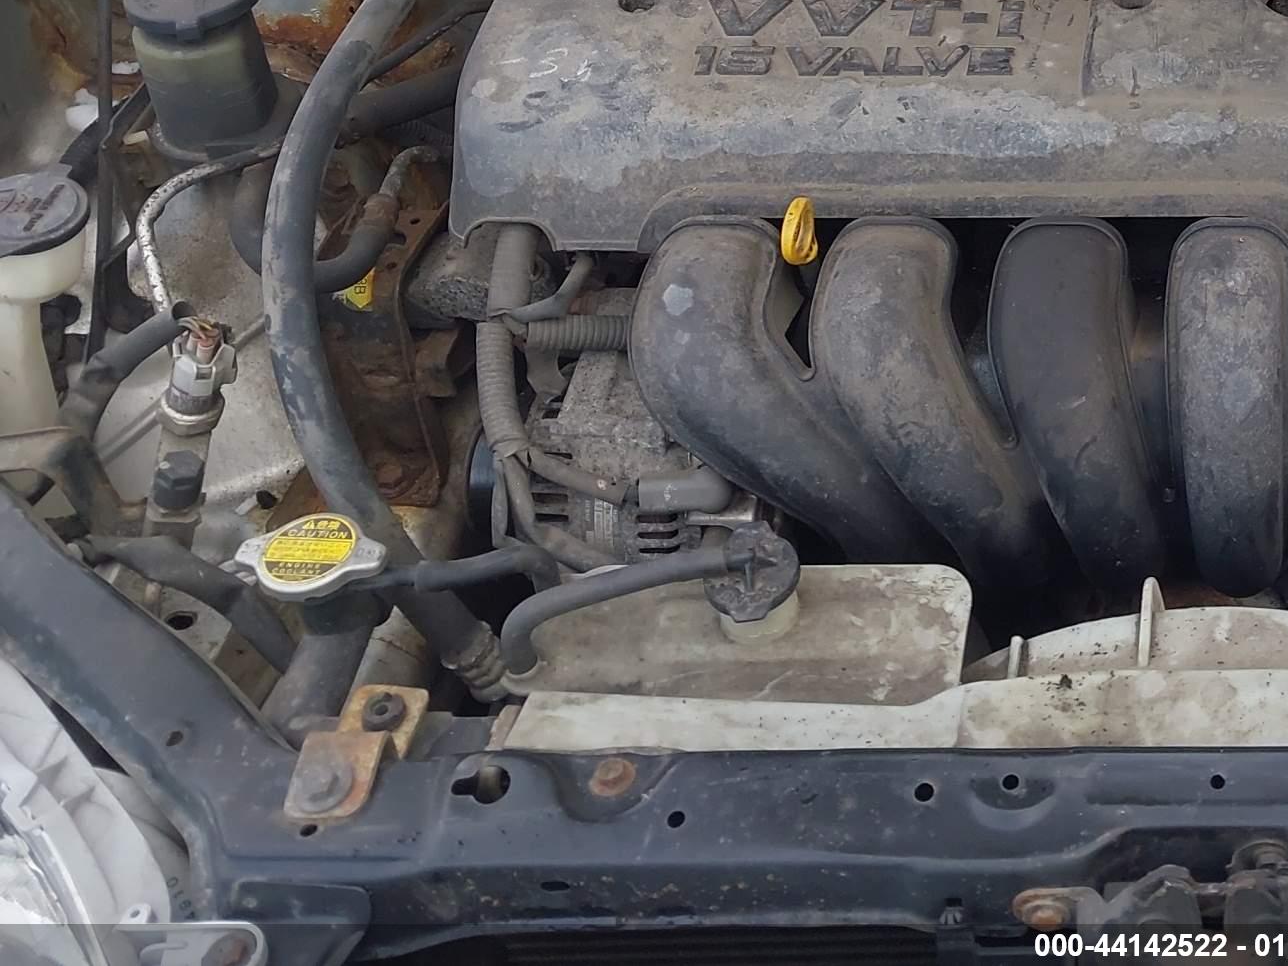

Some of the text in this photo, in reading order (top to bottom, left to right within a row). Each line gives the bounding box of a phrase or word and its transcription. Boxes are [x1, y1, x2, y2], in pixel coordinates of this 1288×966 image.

[695, 45, 1016, 77] 16 VALVE
[287, 528, 348, 539] CAUTION
